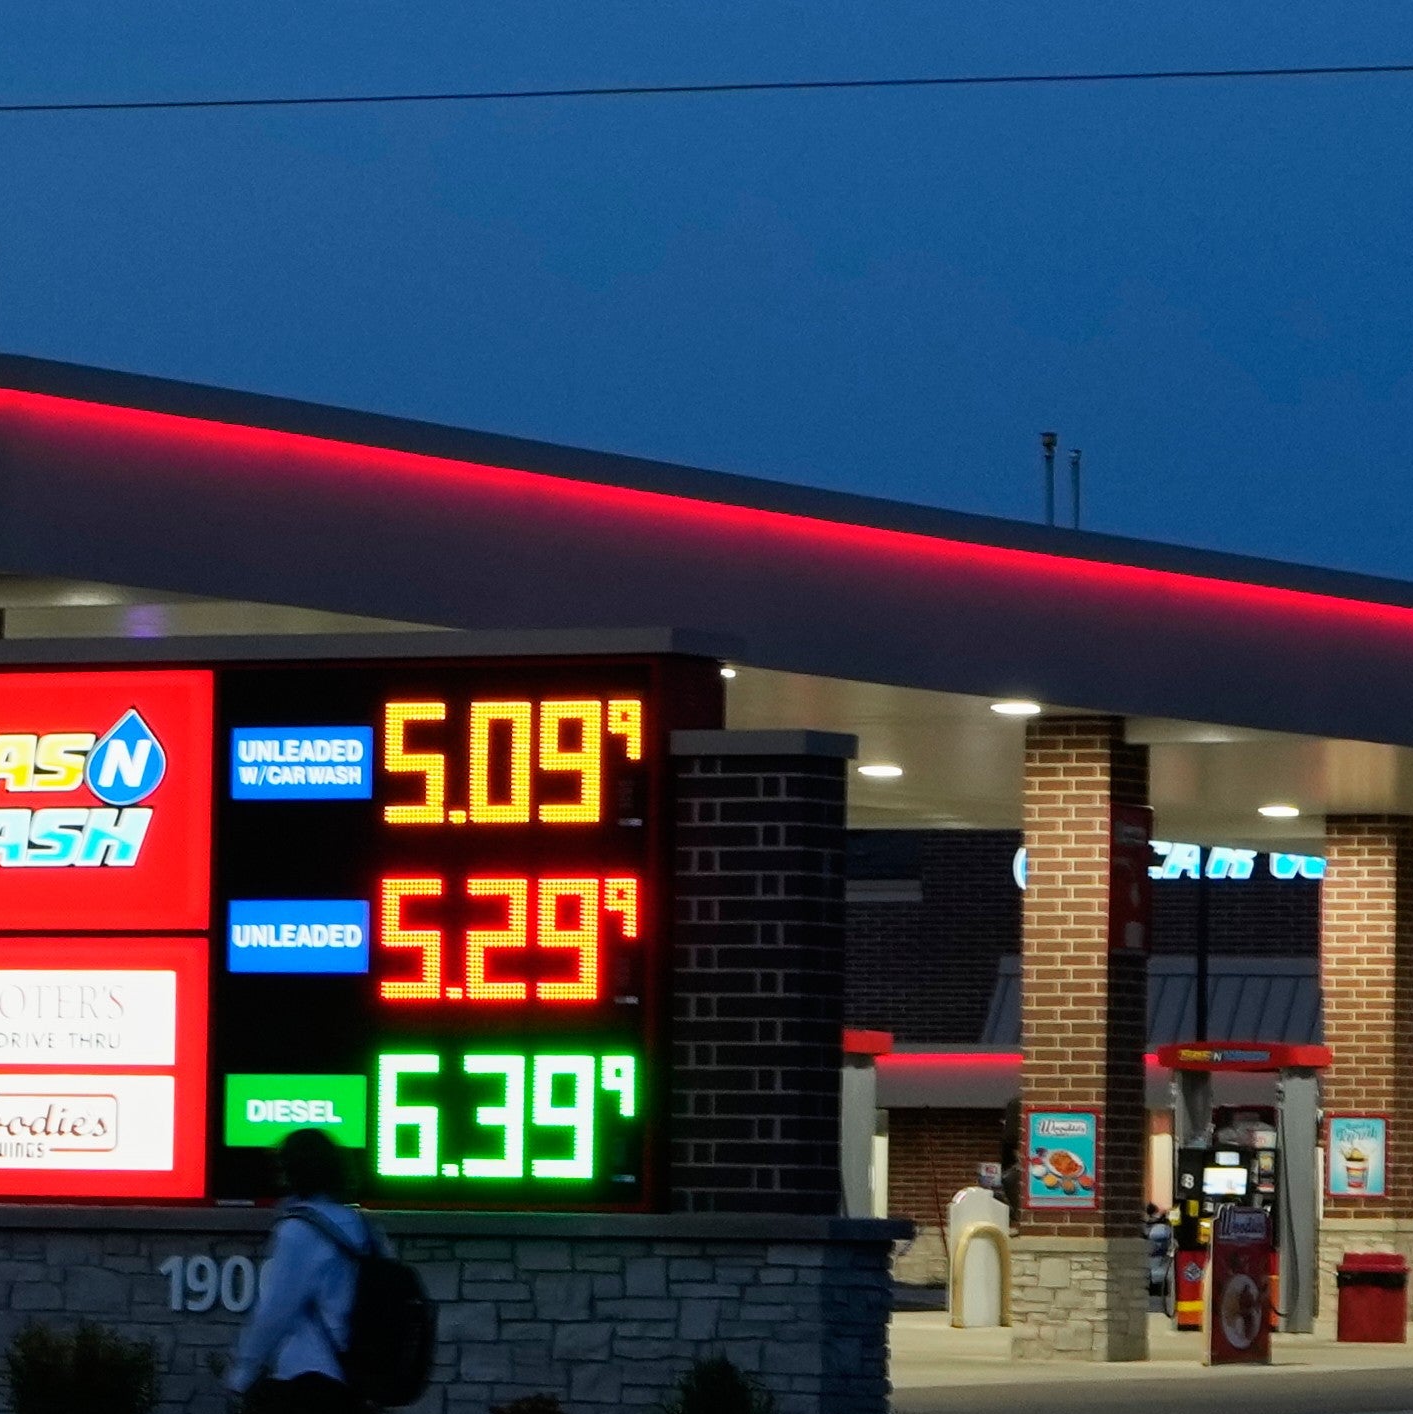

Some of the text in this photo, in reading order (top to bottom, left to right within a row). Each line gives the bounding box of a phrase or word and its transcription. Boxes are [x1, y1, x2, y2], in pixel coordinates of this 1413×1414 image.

[238, 739, 364, 763] UNLEADED
[232, 923, 363, 948] UNLEADED
[68, 1031, 122, 1050] THRU
[246, 1099, 343, 1123] DIESEL
[159, 1254, 278, 1313] 190
